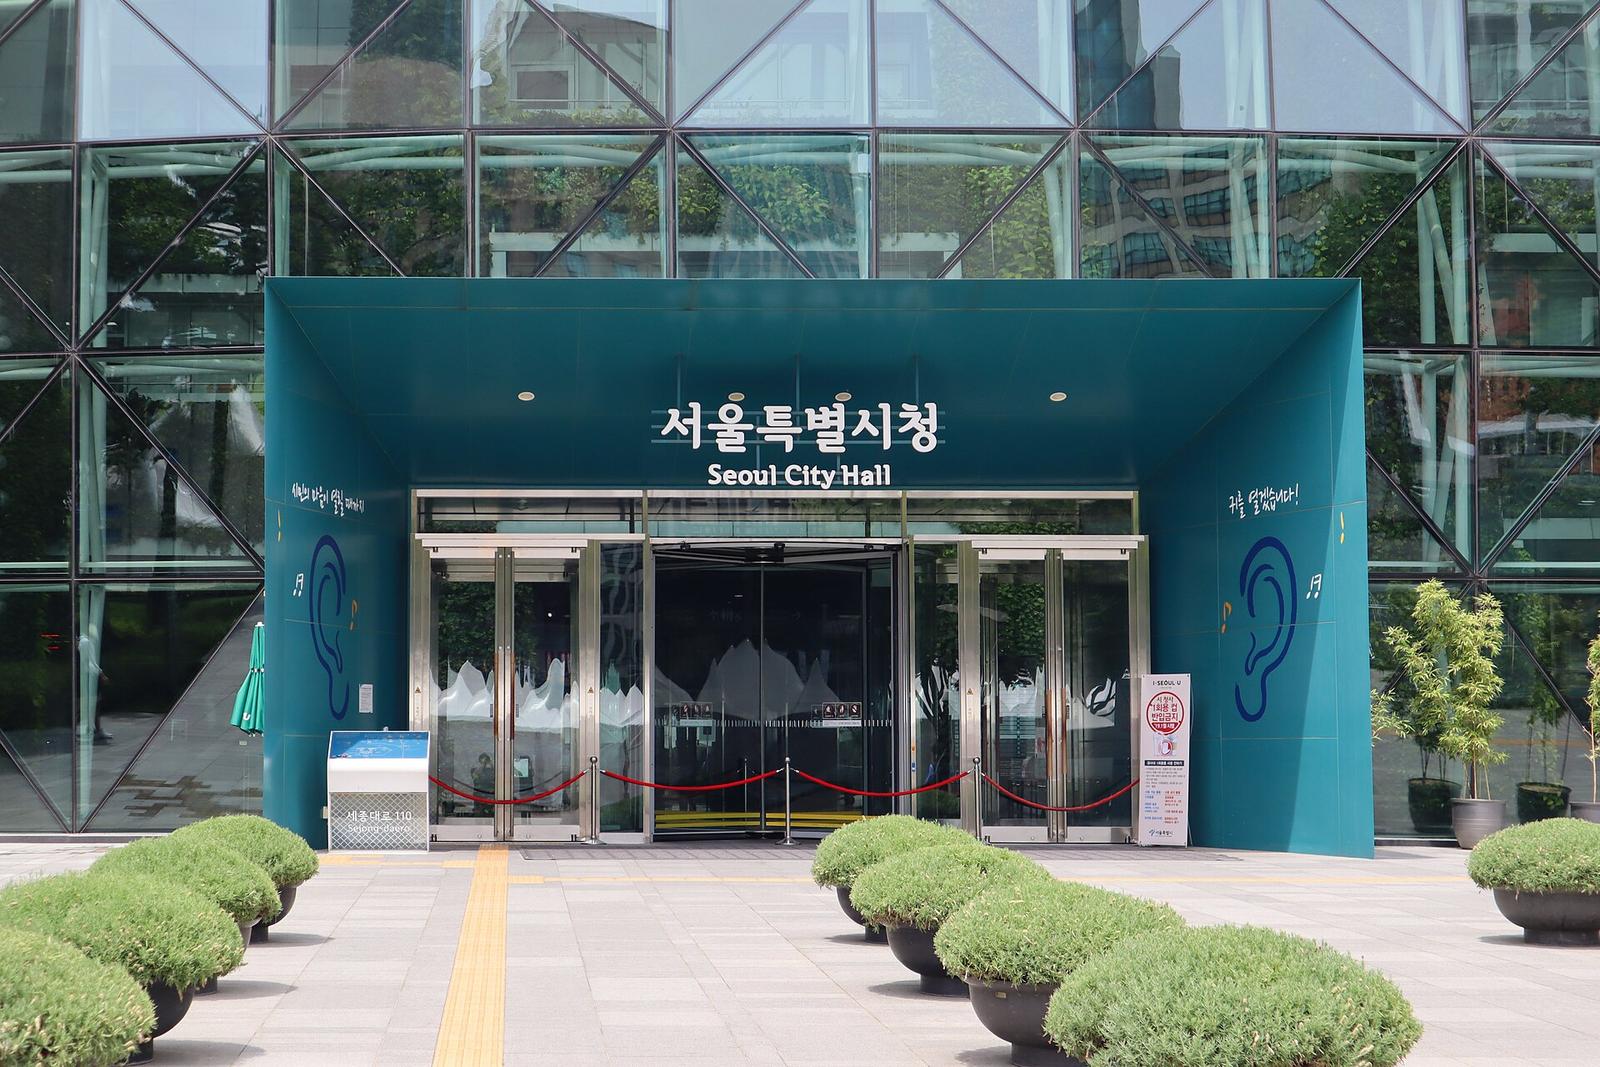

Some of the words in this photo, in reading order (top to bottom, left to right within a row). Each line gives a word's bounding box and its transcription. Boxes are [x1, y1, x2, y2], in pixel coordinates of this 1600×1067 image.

[660, 401, 938, 453] 서울특별시청
[707, 463, 777, 486] Seoul
[784, 464, 836, 490] City
[841, 464, 891, 486] Hall
[292, 482, 310, 502] 시민의
[312, 485, 329, 509] 마음이
[1229, 490, 1246, 519] 귀를
[1248, 482, 1299, 515] 열겠습니다!
[1152, 713, 1178, 721] 반입금지
[1153, 703, 1169, 712] 1회용
[1172, 703, 1178, 712] 컵
[346, 810, 394, 822] 세종대로
[395, 810, 412, 820] 110
[347, 823, 410, 834] Sejong-daero
